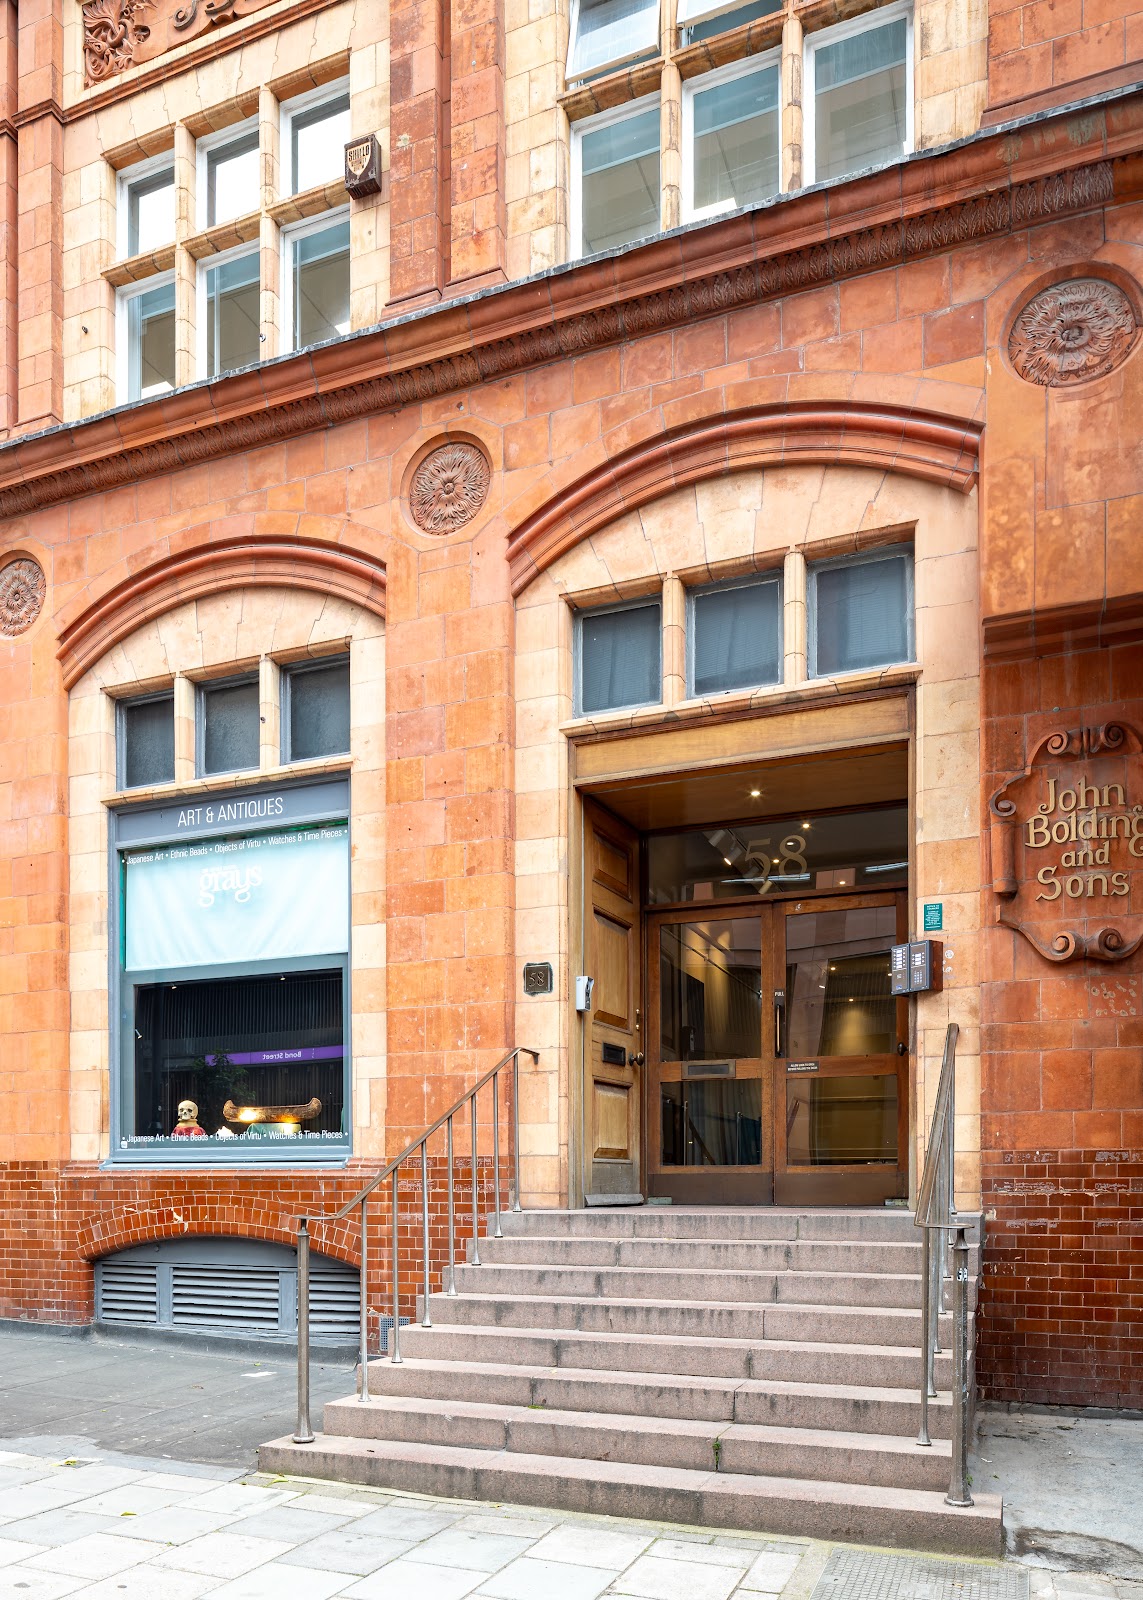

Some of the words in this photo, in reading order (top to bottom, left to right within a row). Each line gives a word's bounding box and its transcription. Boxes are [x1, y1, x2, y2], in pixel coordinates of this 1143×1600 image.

[177, 808, 203, 828] ART
[206, 806, 215, 823] &
[217, 797, 284, 822] ANTIQUES
[1038, 775, 1126, 815] John
[126, 854, 154, 865] Japanese
[154, 852, 164, 861] Art
[170, 848, 188, 859] Ethnic
[189, 846, 208, 857] Beads
[214, 842, 238, 854] Objects
[238, 840, 246, 850] of
[246, 839, 261, 849] Virtu
[268, 833, 296, 846] Watches
[297, 832, 302, 842] &
[303, 831, 320, 841] Time
[321, 828, 343, 840] Pieces
[1025, 804, 1143, 857] Bolding
[745, 835, 808, 883] 58
[1061, 841, 1110, 868] and
[197, 864, 263, 907] grays
[1035, 866, 1130, 901] Sons
[528, 971, 545, 988] 58
[127, 1134, 154, 1144] Japanese
[155, 1133, 165, 1142] Art
[171, 1132, 189, 1142] Ethnic
[190, 1131, 209, 1142] Beads
[215, 1131, 238, 1143] Objects
[239, 1131, 246, 1140] of
[247, 1130, 262, 1140] Virtu
[268, 1130, 296, 1140] Watches
[298, 1130, 303, 1140] &
[304, 1130, 320, 1139] Time
[321, 1129, 343, 1139] Pieces
